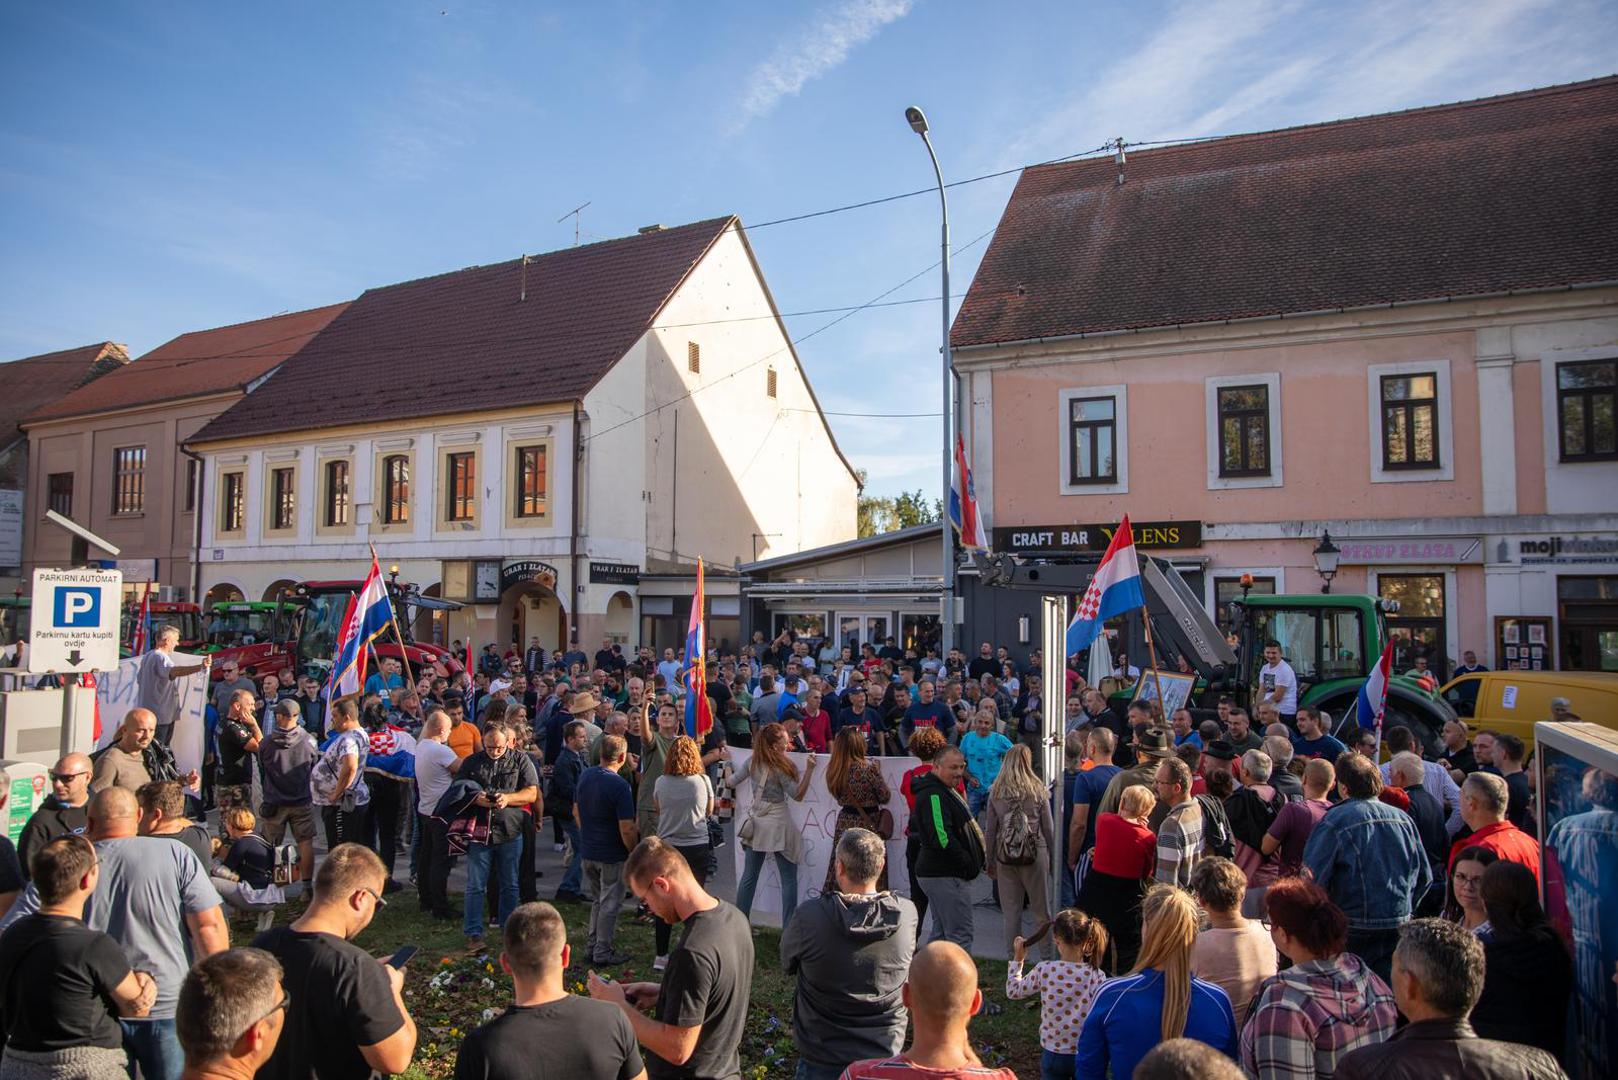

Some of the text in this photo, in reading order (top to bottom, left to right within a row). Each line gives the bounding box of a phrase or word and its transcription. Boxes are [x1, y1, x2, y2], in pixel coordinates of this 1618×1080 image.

[1012, 532, 1054, 547] CRAFT
[1061, 531, 1089, 545] BAR
[39, 574, 118, 583] PARKIRNI AUTOMAT
[64, 591, 94, 624] P
[36, 631, 113, 641] Parkirnu kartu kupiti
[64, 640, 86, 648] ovdje
